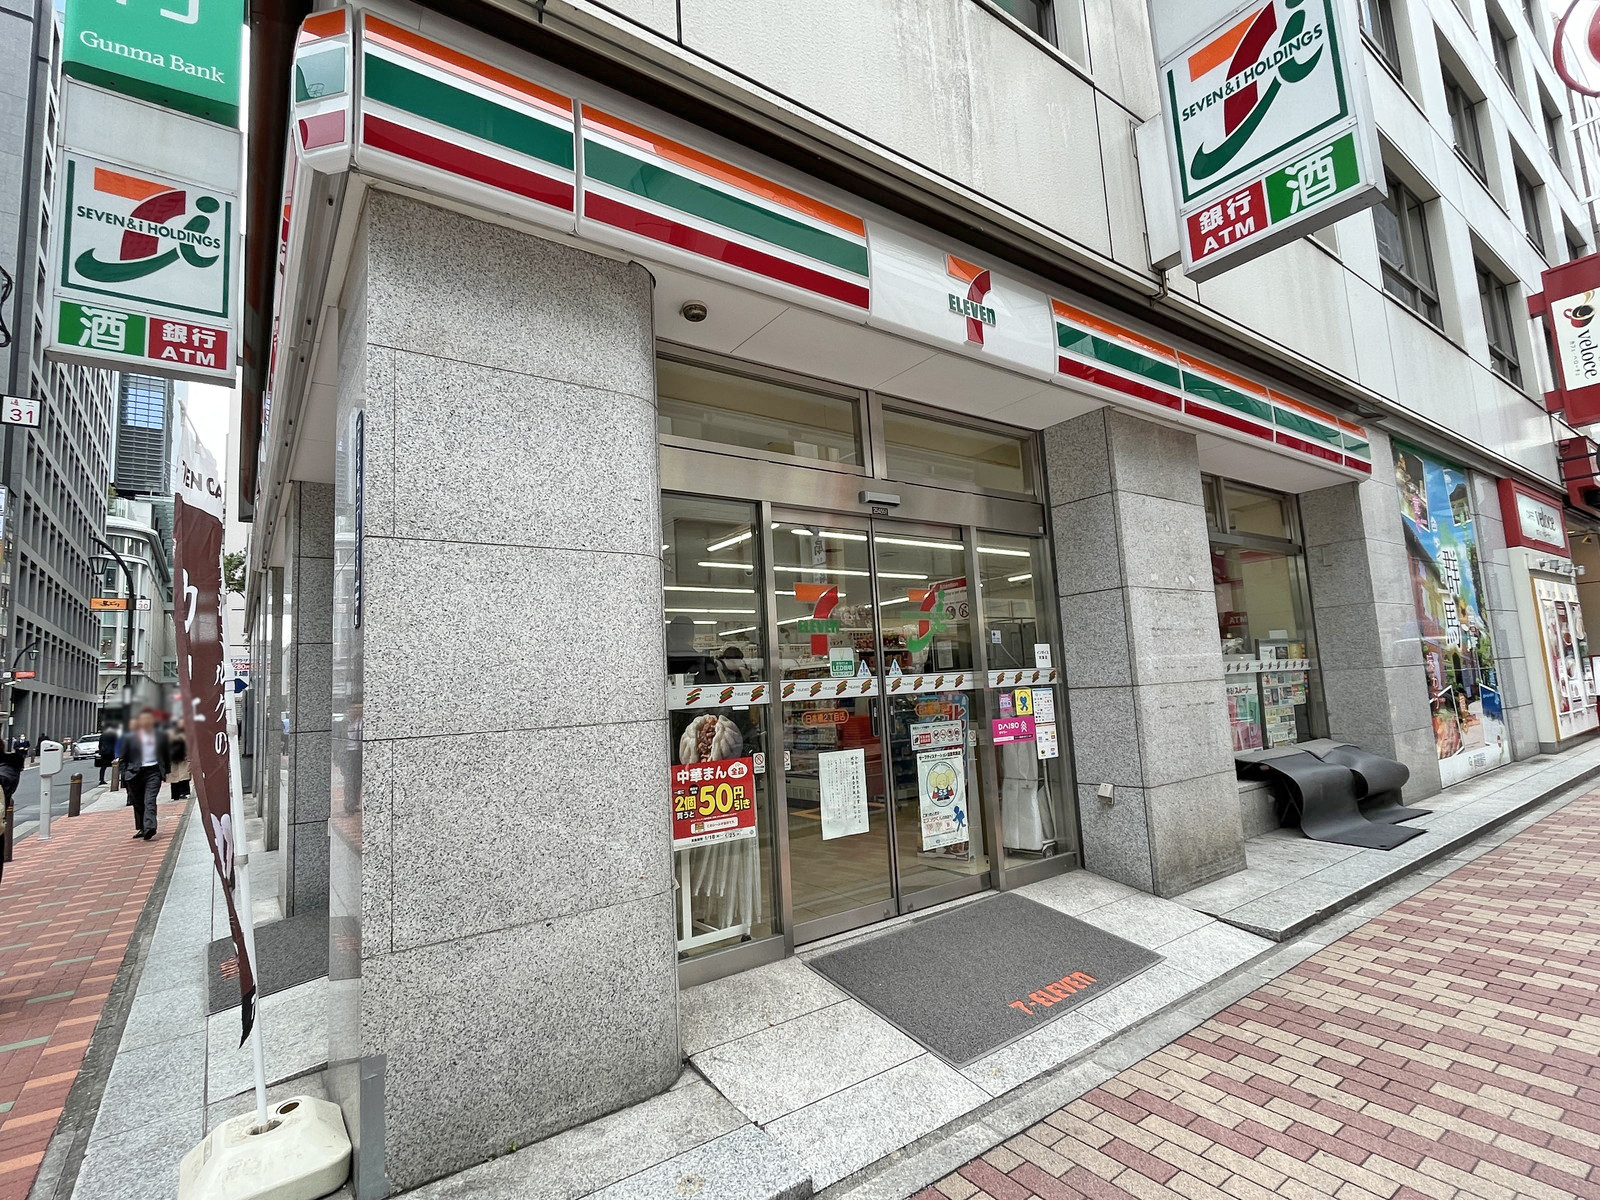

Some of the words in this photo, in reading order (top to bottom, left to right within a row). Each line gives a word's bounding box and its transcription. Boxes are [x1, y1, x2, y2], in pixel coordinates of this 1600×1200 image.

[80, 30, 165, 67] Gunma
[169, 54, 225, 84] Bank
[1243, 24, 1323, 83] HOLDINGS
[1285, 145, 1337, 214] 酒
[1198, 190, 1252, 235] 銀行
[148, 223, 220, 249] HOLDINGS
[1202, 216, 1256, 255] ATM
[79, 306, 129, 352] 酒
[162, 322, 216, 349] 銀行
[161, 346, 215, 367] ATM
[1578, 329, 1598, 379] veloce
[10, 408, 33, 423] 31
[1229, 616, 1247, 624] ATM
[998, 722, 1019, 730] DAISO
[676, 766, 727, 784] 中華まん
[675, 795, 697, 812] 2個
[698, 783, 733, 816] 50
[734, 799, 751, 811] 引き
[676, 811, 695, 820] 買うと
